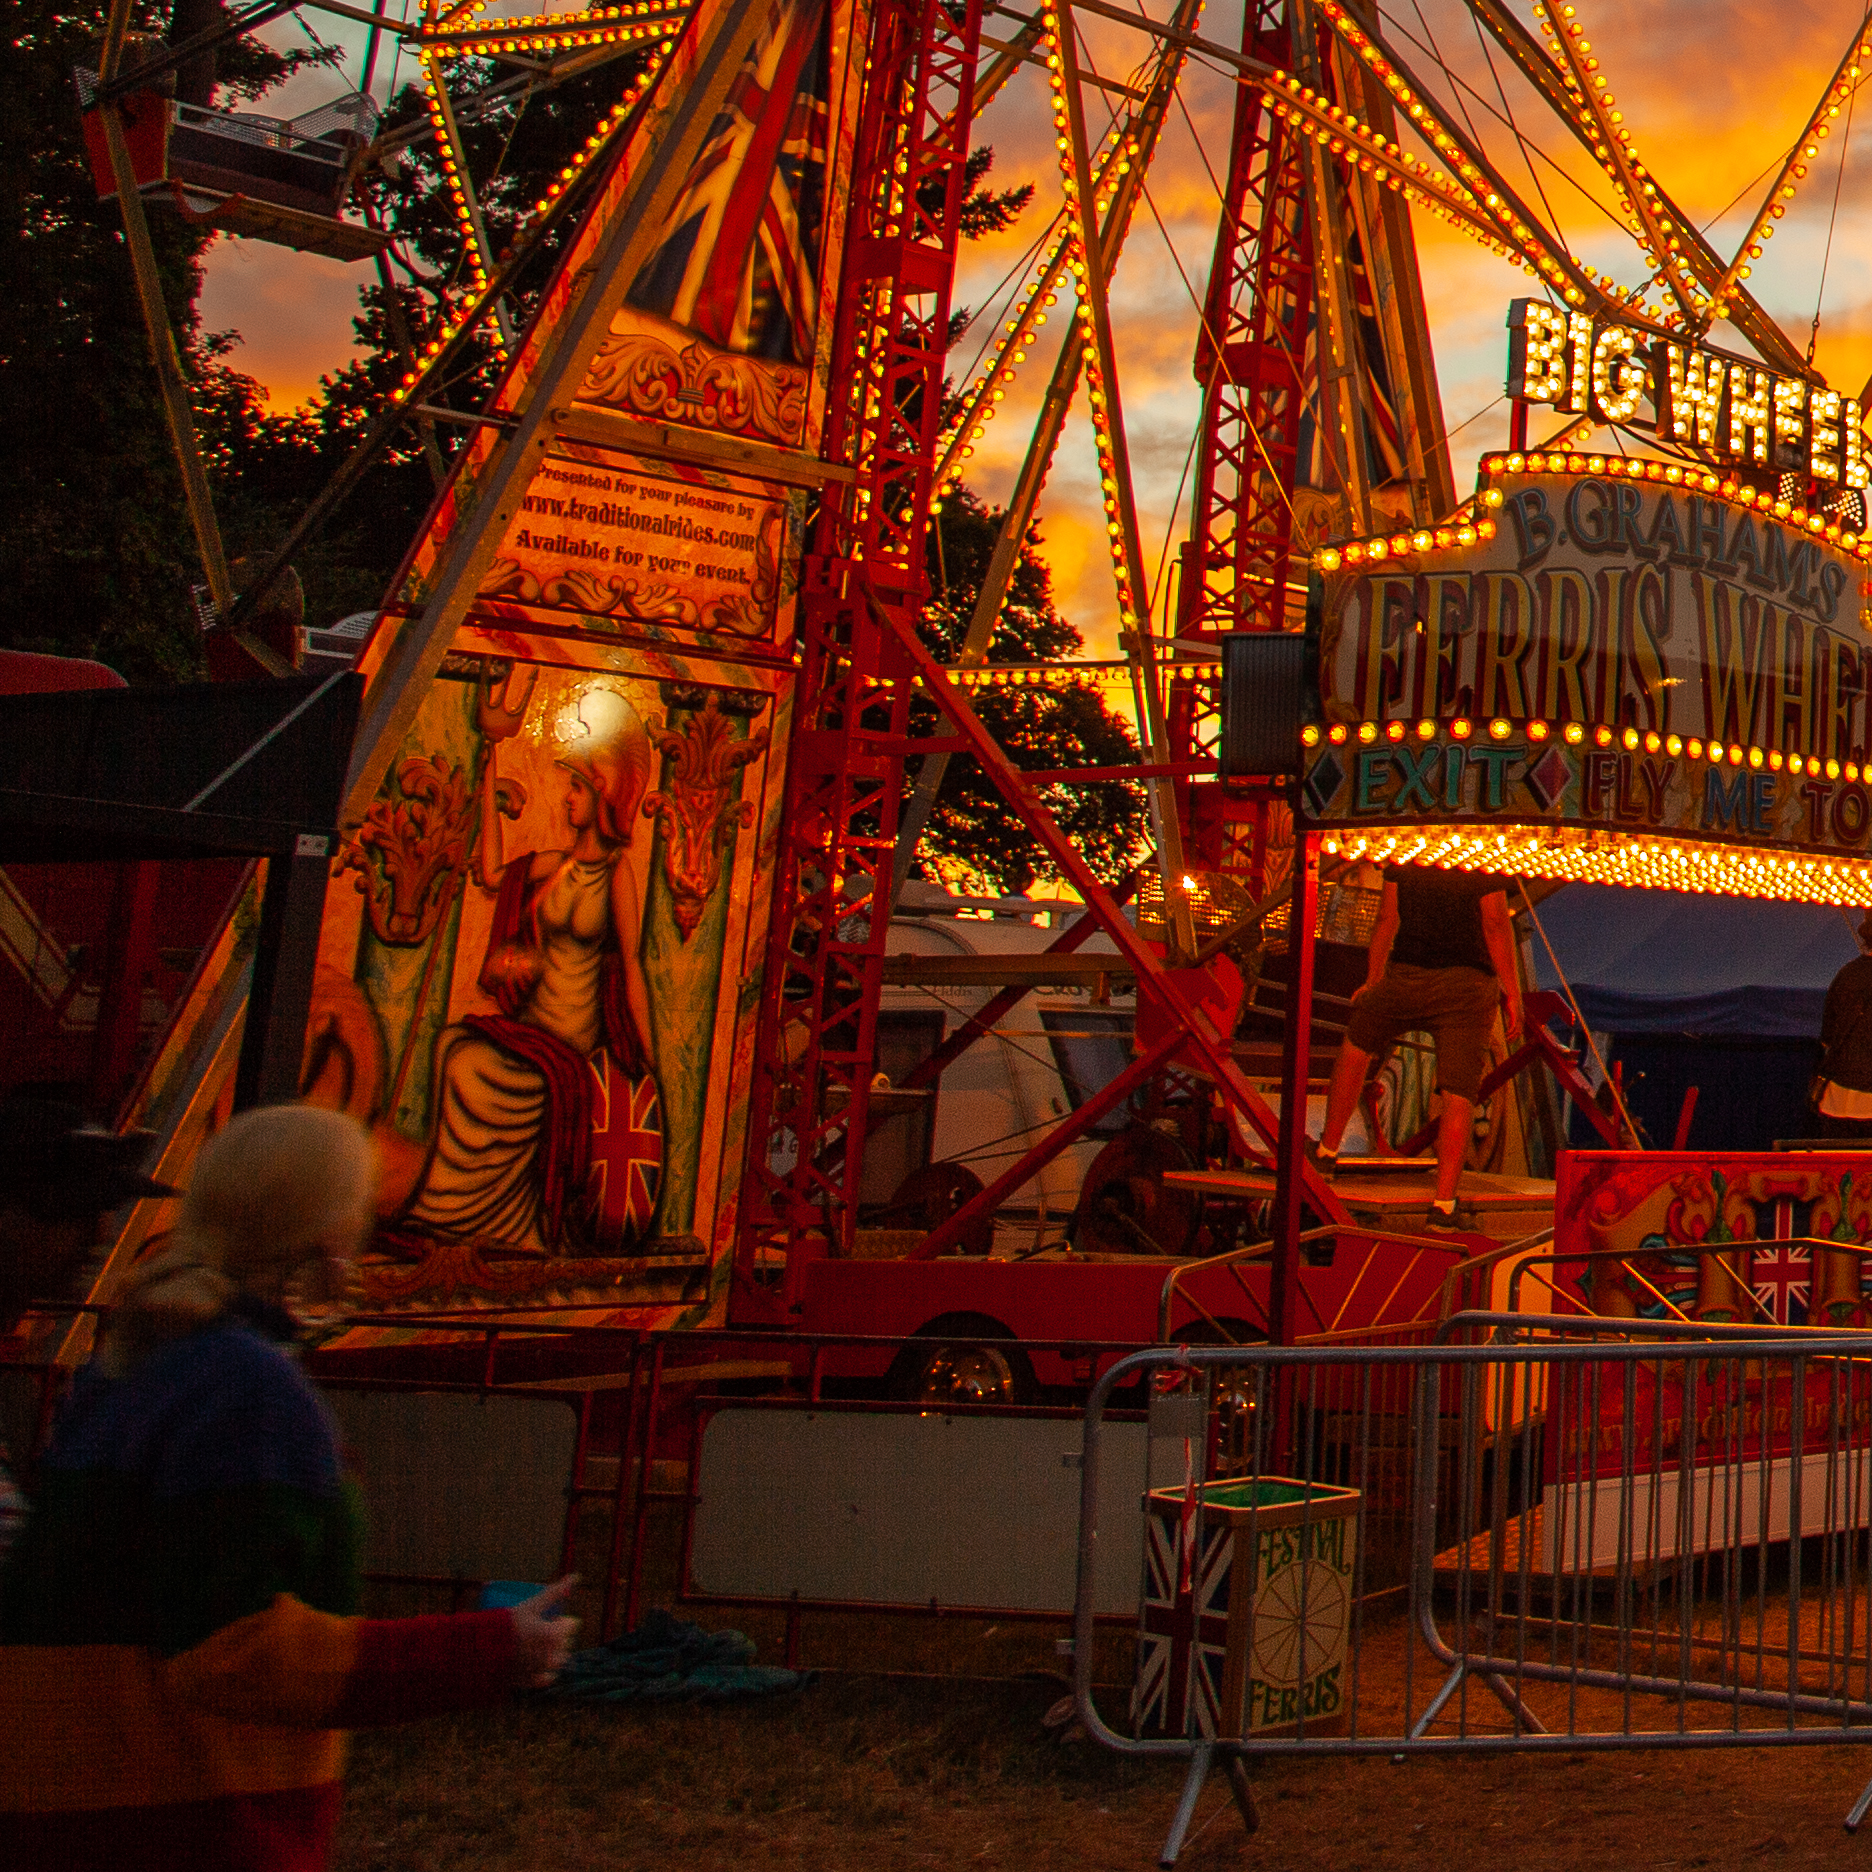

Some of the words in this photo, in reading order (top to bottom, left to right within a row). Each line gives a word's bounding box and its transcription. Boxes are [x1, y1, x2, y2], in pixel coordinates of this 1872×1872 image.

[1518, 300, 1645, 426] BIG
[1662, 340, 1869, 491] WHEEL
[522, 494, 757, 551] www.traditionalrides.com
[538, 462, 612, 492] Presented
[614, 478, 636, 495] for
[640, 486, 673, 502] your
[674, 491, 735, 516] pleasure
[737, 501, 756, 522] by
[516, 529, 610, 562] Available
[614, 545, 644, 567] for
[694, 561, 752, 585] event.
[1350, 560, 1684, 730] FERRIS
[1356, 740, 1528, 814] EXIT
[1580, 748, 1682, 823] FLY
[1704, 762, 1780, 837] ME
[1801, 778, 1872, 846] TO
[1250, 1660, 1342, 1727] FERRIS
